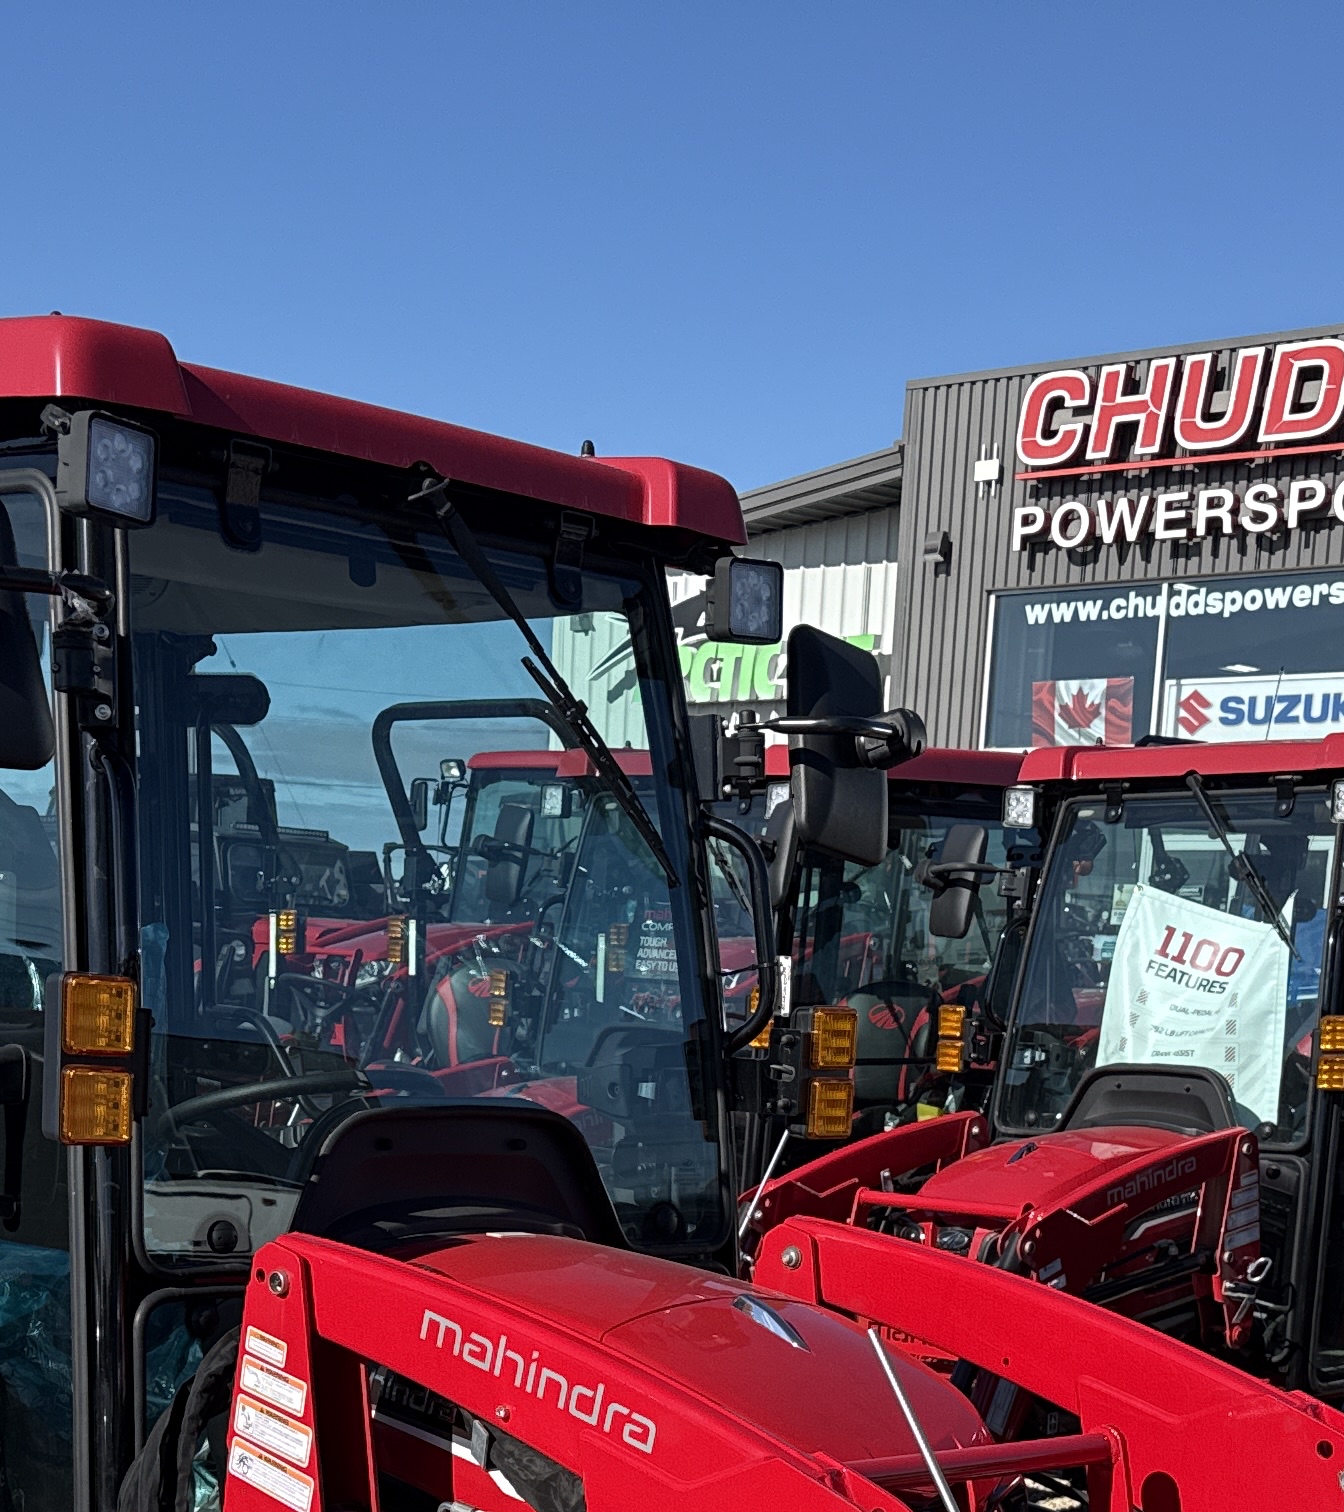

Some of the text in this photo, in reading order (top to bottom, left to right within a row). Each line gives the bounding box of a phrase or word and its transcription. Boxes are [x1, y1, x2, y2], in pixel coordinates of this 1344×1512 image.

[1145, 959, 1229, 994] FEATURES
[1154, 925, 1245, 977] 1100
[1106, 1156, 1197, 1206] mahindra
[419, 1308, 657, 1455] mahindra
